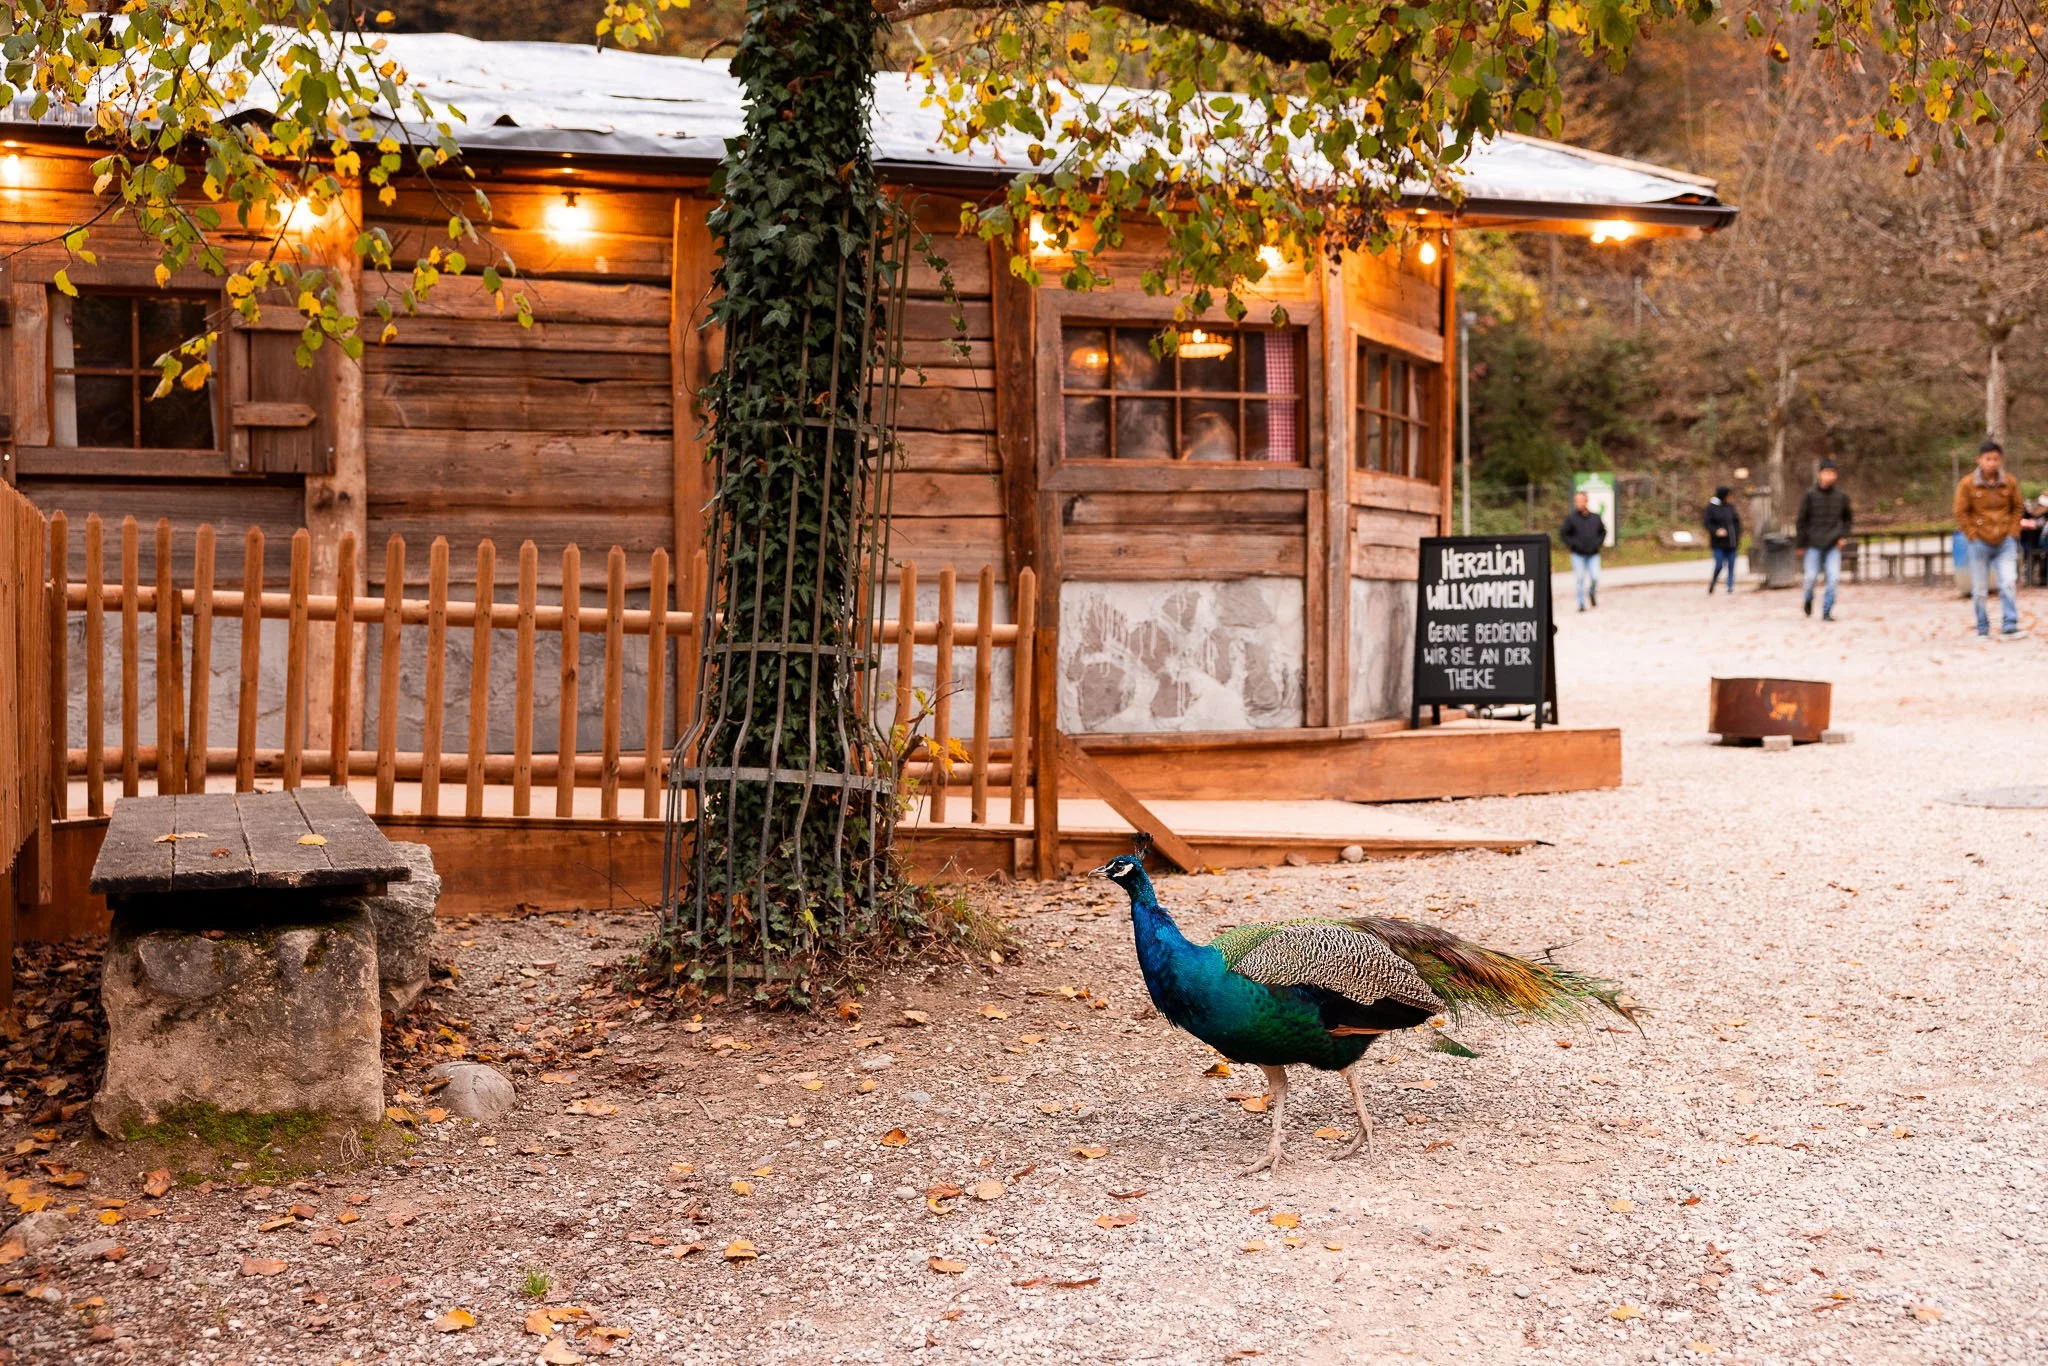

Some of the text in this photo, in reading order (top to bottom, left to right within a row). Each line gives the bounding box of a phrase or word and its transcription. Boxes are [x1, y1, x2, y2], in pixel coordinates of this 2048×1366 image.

[1441, 544, 1525, 580] HERZLICH
[1426, 579, 1534, 611] WILLKOMMEN
[1428, 619, 1538, 644] GERNE BEDIENEN
[1424, 644, 1532, 666] WIR SIE AN DER
[1444, 667, 1496, 691] THEKE
